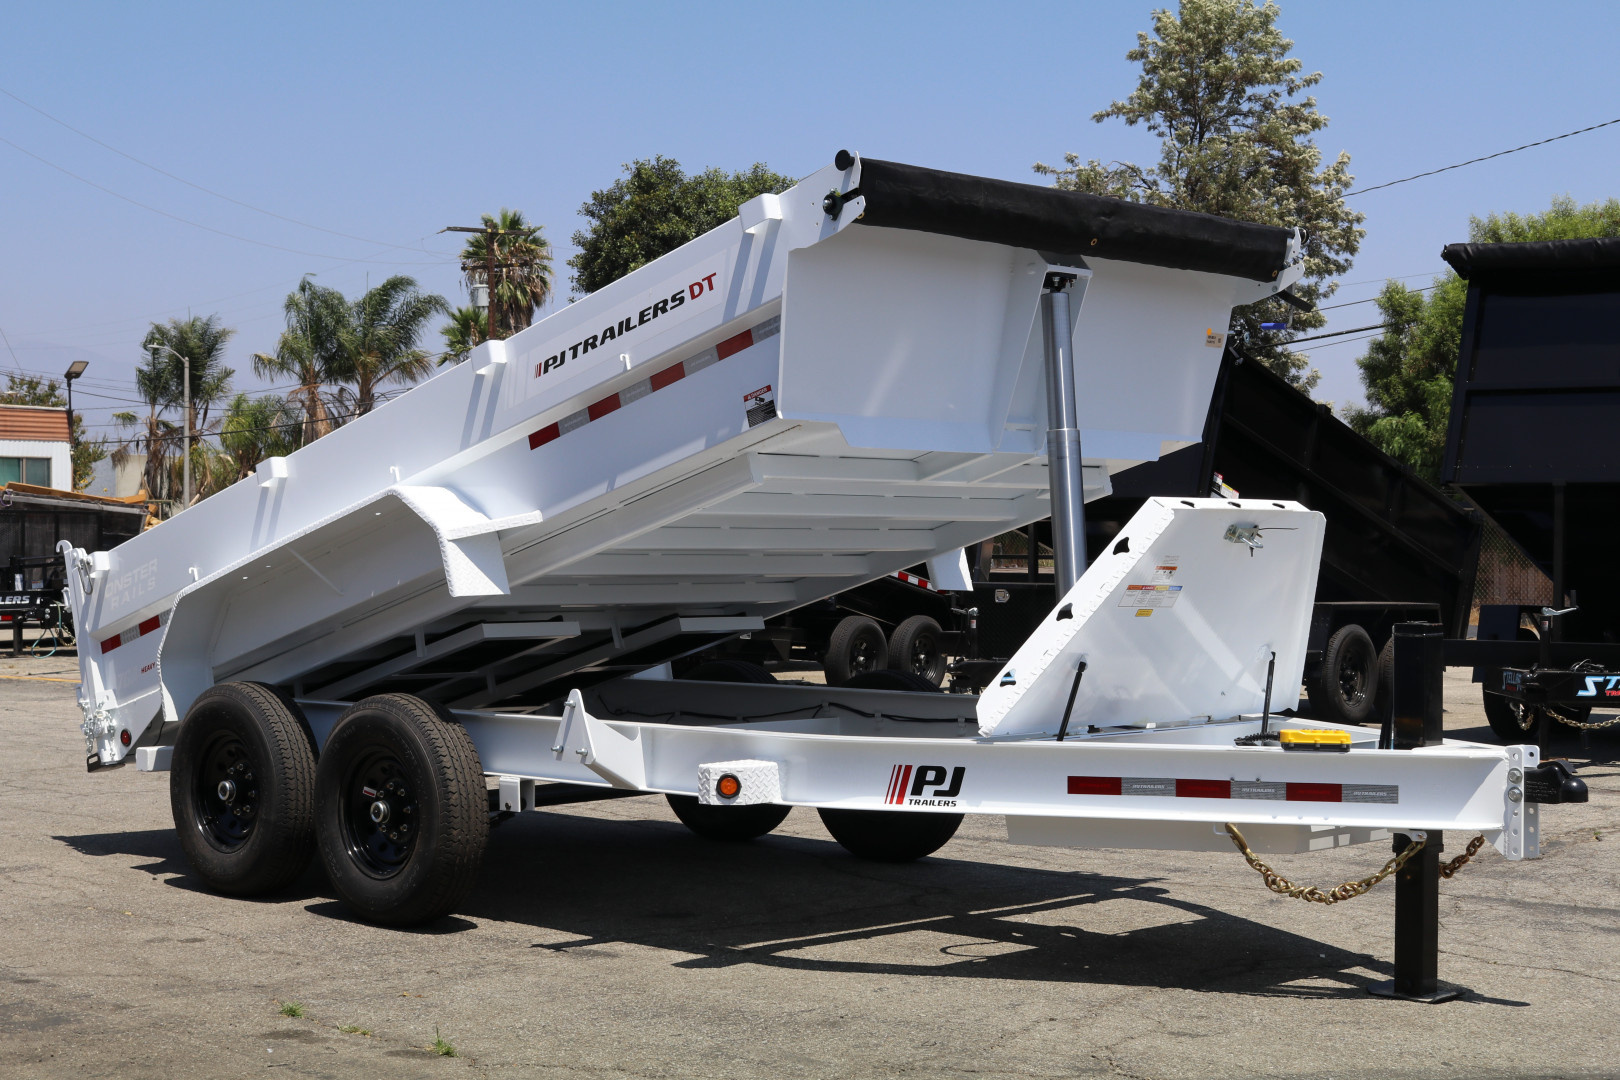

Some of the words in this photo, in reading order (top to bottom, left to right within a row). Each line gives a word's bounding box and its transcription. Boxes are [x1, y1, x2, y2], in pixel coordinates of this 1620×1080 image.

[543, 349, 566, 375] PJ
[568, 289, 686, 360] TRAILERS
[688, 272, 717, 301] DT
[105, 559, 158, 599] ONSTER
[910, 765, 966, 798] PJ
[908, 798, 957, 807] TRAILERS
